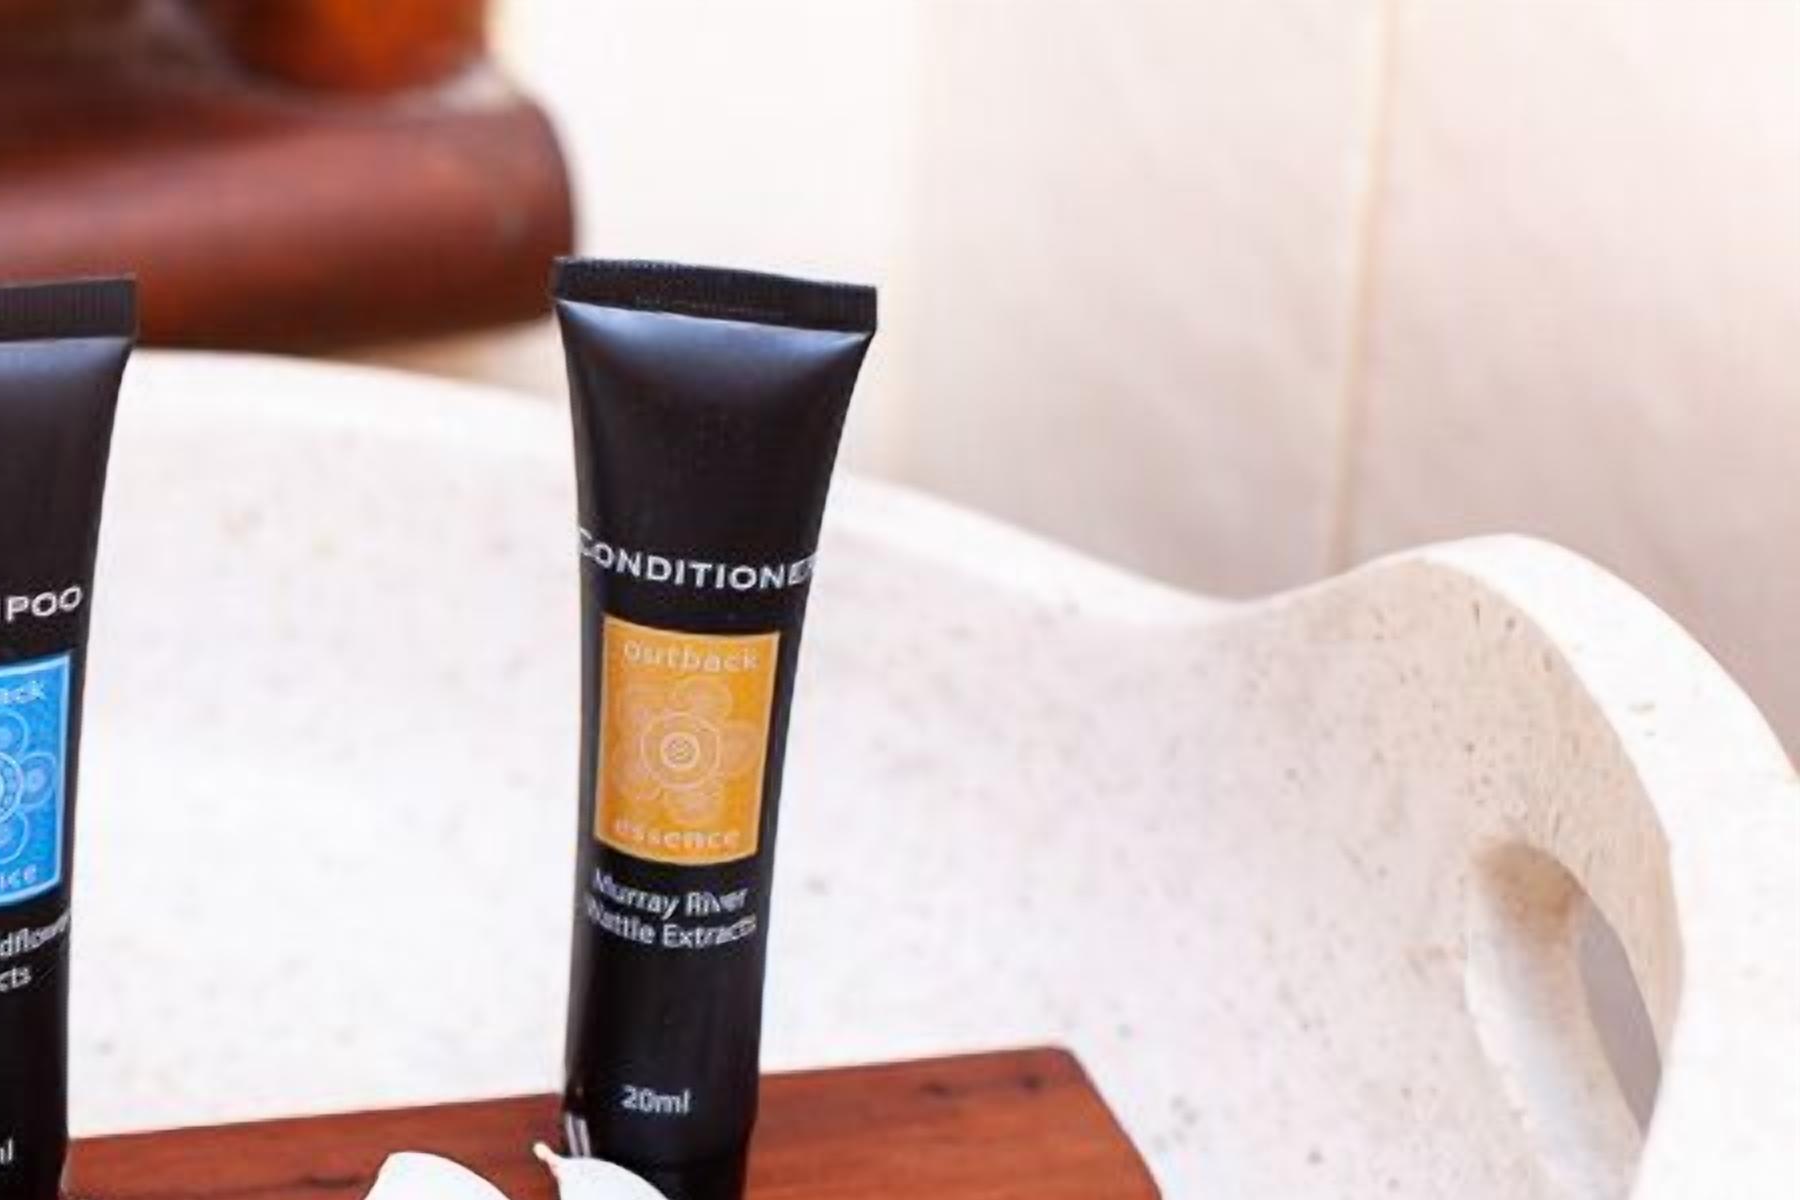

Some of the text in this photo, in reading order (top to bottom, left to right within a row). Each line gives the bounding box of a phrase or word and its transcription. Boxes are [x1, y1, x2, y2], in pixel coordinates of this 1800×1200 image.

[624, 640, 761, 673] outback
[615, 818, 740, 850] essence
[685, 887, 749, 917] River
[621, 1084, 691, 1116] 20ml
